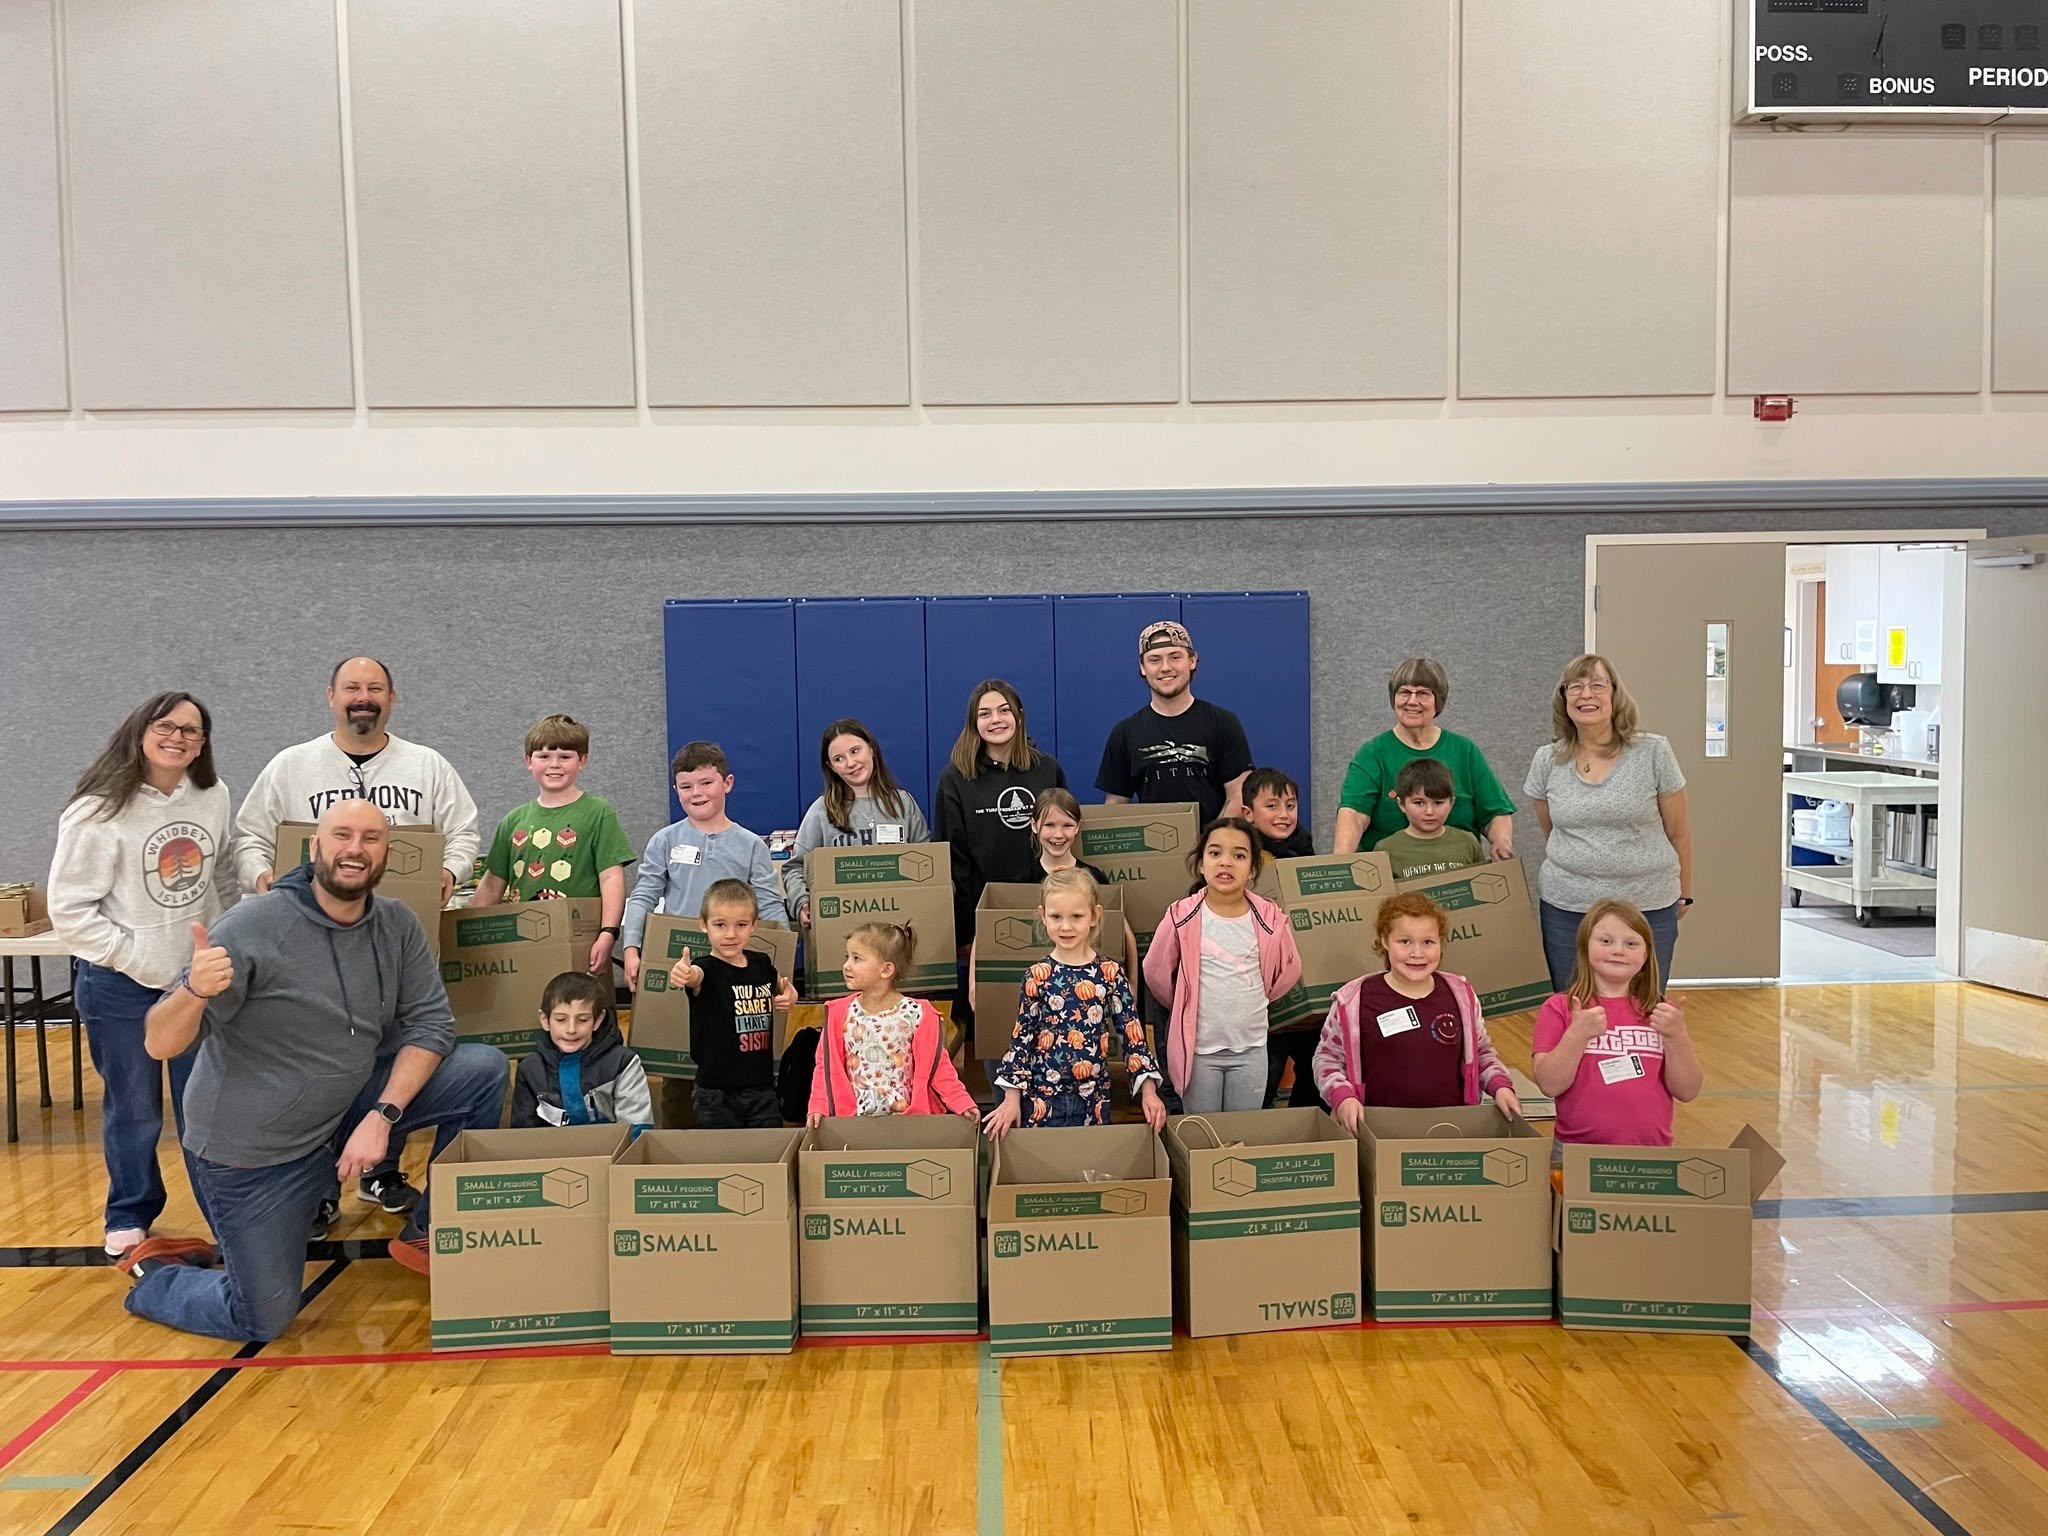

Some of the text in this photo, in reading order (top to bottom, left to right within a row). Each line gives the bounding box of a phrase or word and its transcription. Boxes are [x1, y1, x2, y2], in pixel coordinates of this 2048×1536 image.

[1755, 44, 1813, 62] POSS.
[1968, 67, 2048, 87] PERIOD
[1869, 77, 1935, 95] BONUS
[148, 826, 207, 856] WHIDBEY
[840, 860, 863, 868] SMALL
[1105, 867, 1147, 882] MALL
[158, 880, 206, 903] ISLAND
[842, 897, 900, 914] SMALL
[1312, 907, 1363, 926] SMALL
[675, 934, 700, 944] SMALL
[1446, 923, 1482, 943] ALL
[464, 959, 518, 978] SMALL
[732, 985, 753, 1000] YOU
[734, 998, 766, 1015] SCARE
[744, 1016, 765, 1031] HAVE
[739, 1032, 769, 1052] SIST
[1408, 1158, 1438, 1166] SMALL
[831, 1169, 861, 1178] SMALL
[1597, 1164, 1629, 1174] SMALL
[1299, 1173, 1328, 1183] SMALL
[463, 1180, 496, 1191] SMALL
[641, 1184, 672, 1193] SMALL
[1384, 1212, 1404, 1223] GEAR
[1409, 1205, 1482, 1223] SMALL
[833, 1217, 906, 1236] SMALL
[1243, 1223, 1258, 1234] 12"
[1269, 1221, 1282, 1233] 11"
[1294, 1220, 1308, 1231] 17"
[1571, 1218, 1593, 1230] GEAR
[1599, 1213, 1677, 1233] SMALL
[808, 1225, 828, 1236] GEAR
[439, 1238, 461, 1251] GEAR
[465, 1227, 542, 1249] SMALL
[643, 1234, 718, 1253] SMALL
[1023, 1231, 1099, 1252] SMALL
[618, 1241, 638, 1252] GEAR
[998, 1242, 1018, 1254] GEAR
[1431, 1292, 1498, 1303] 17" x 11" x 12"
[855, 1305, 923, 1317] 17" x 11" x 12"
[1258, 1299, 1328, 1321] SMALL
[1622, 1302, 1694, 1315] 17" x 11" x 12"
[490, 1315, 560, 1329] 17" x 11" x 12"
[1048, 1322, 1117, 1335] 17" x 11" x 12"
[667, 1323, 735, 1335] 17" x 11" x 12"
